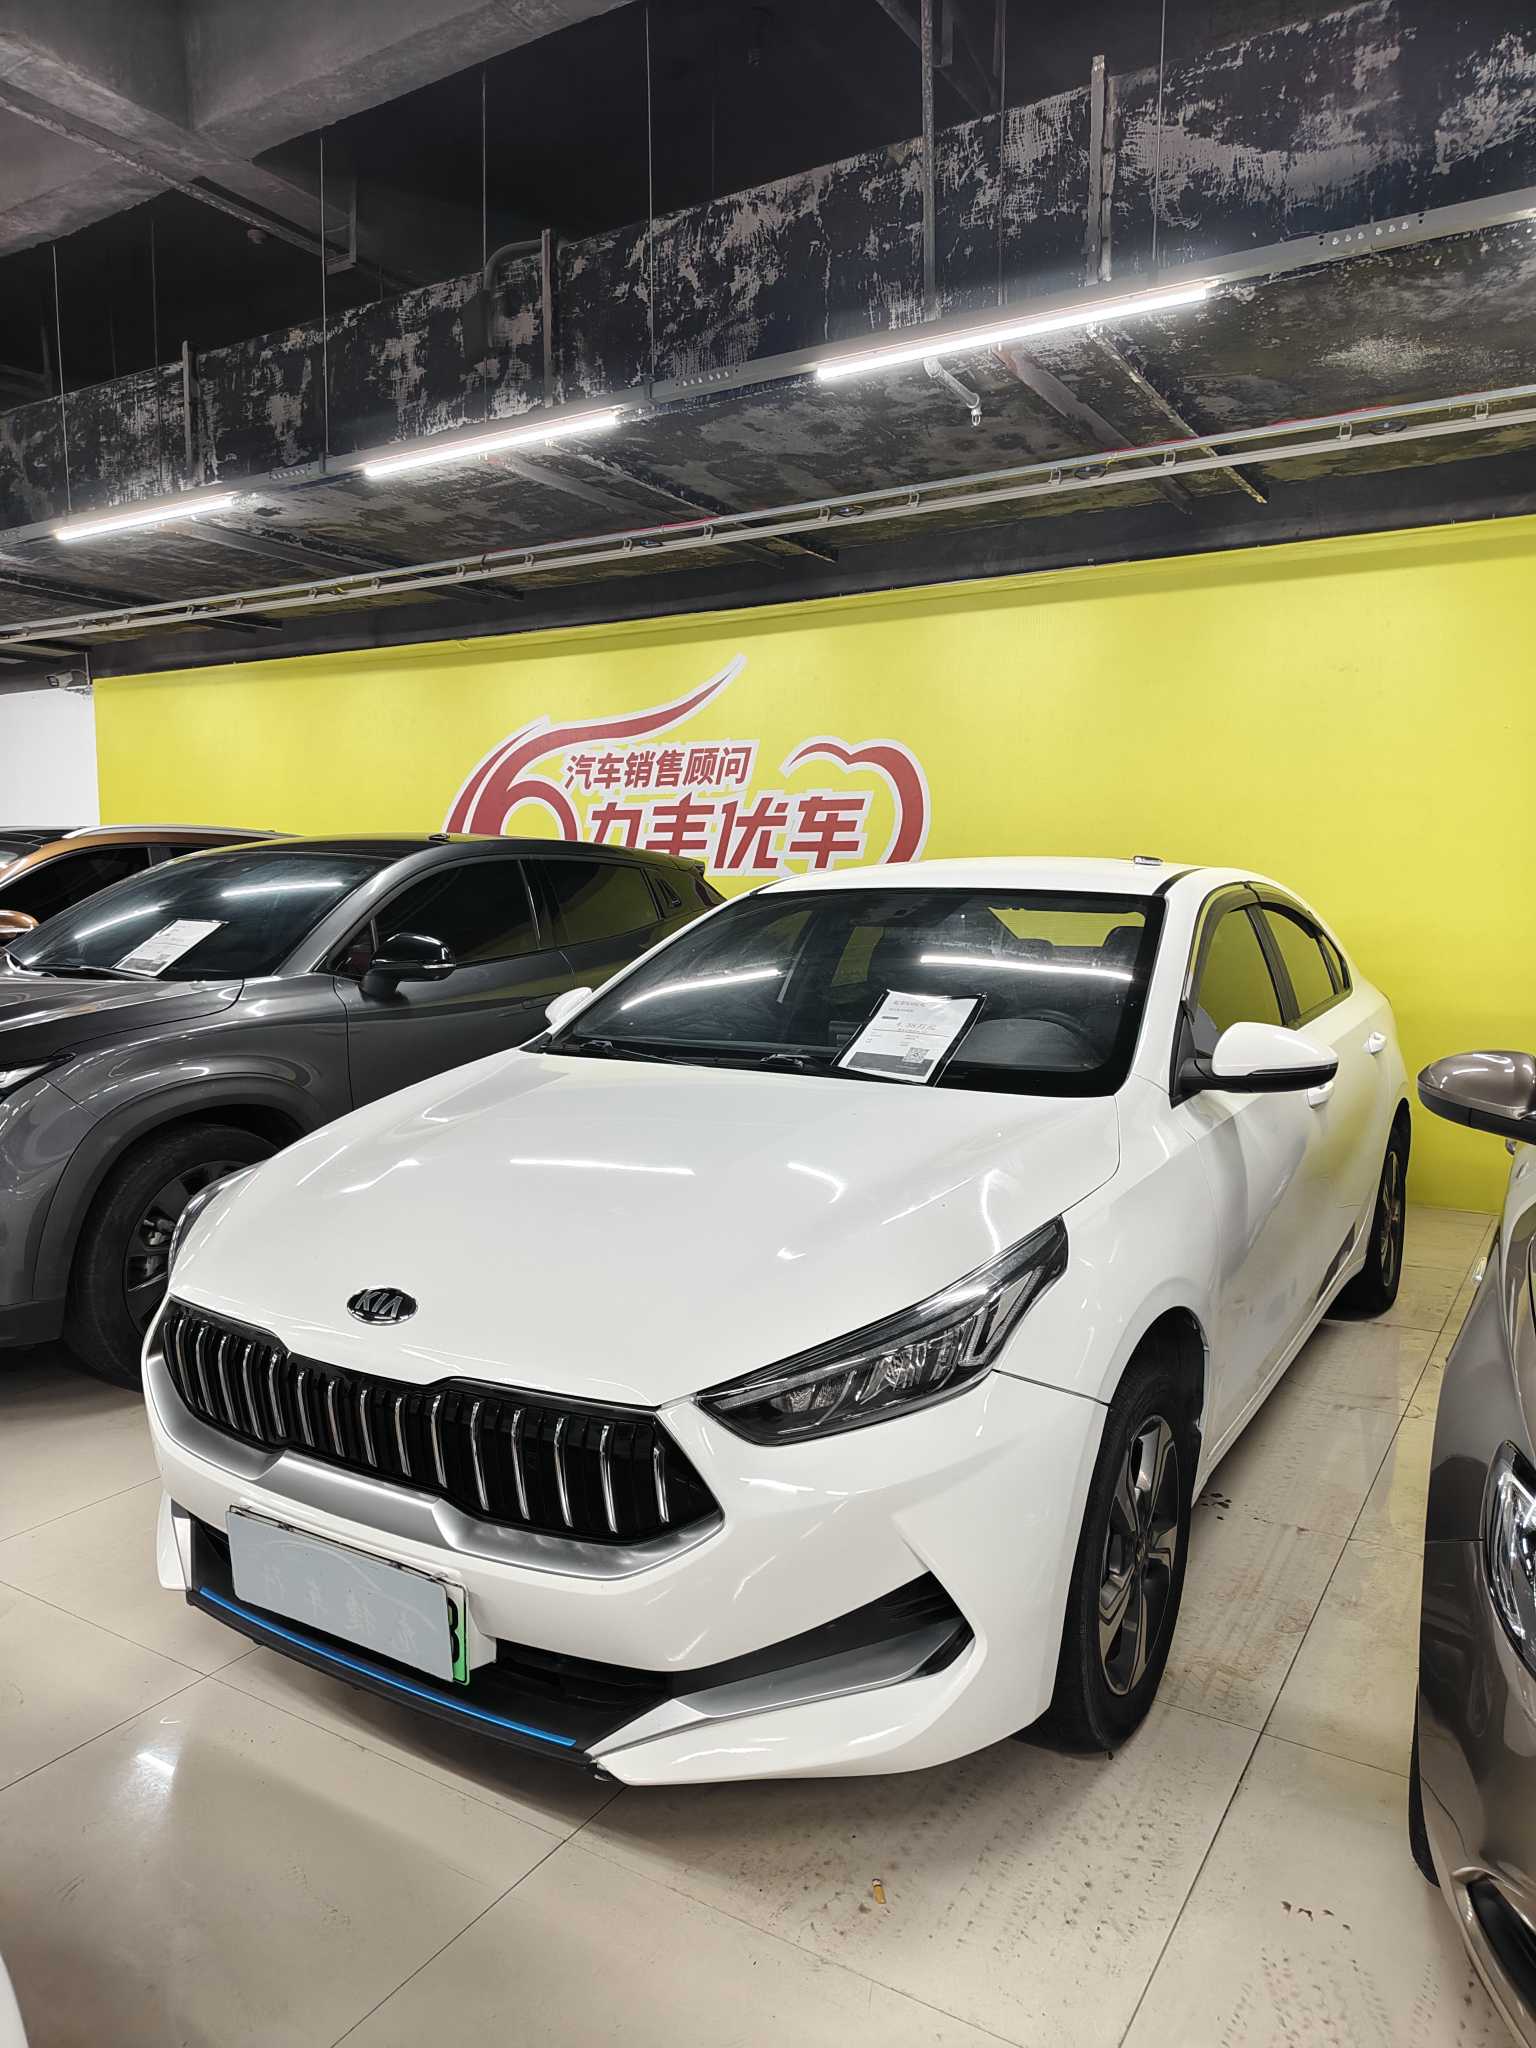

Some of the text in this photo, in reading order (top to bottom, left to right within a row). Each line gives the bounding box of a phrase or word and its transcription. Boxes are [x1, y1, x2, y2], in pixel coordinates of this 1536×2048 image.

[564, 746, 752, 790] 汽车销售顾问
[354, 1290, 404, 1318] KIA
